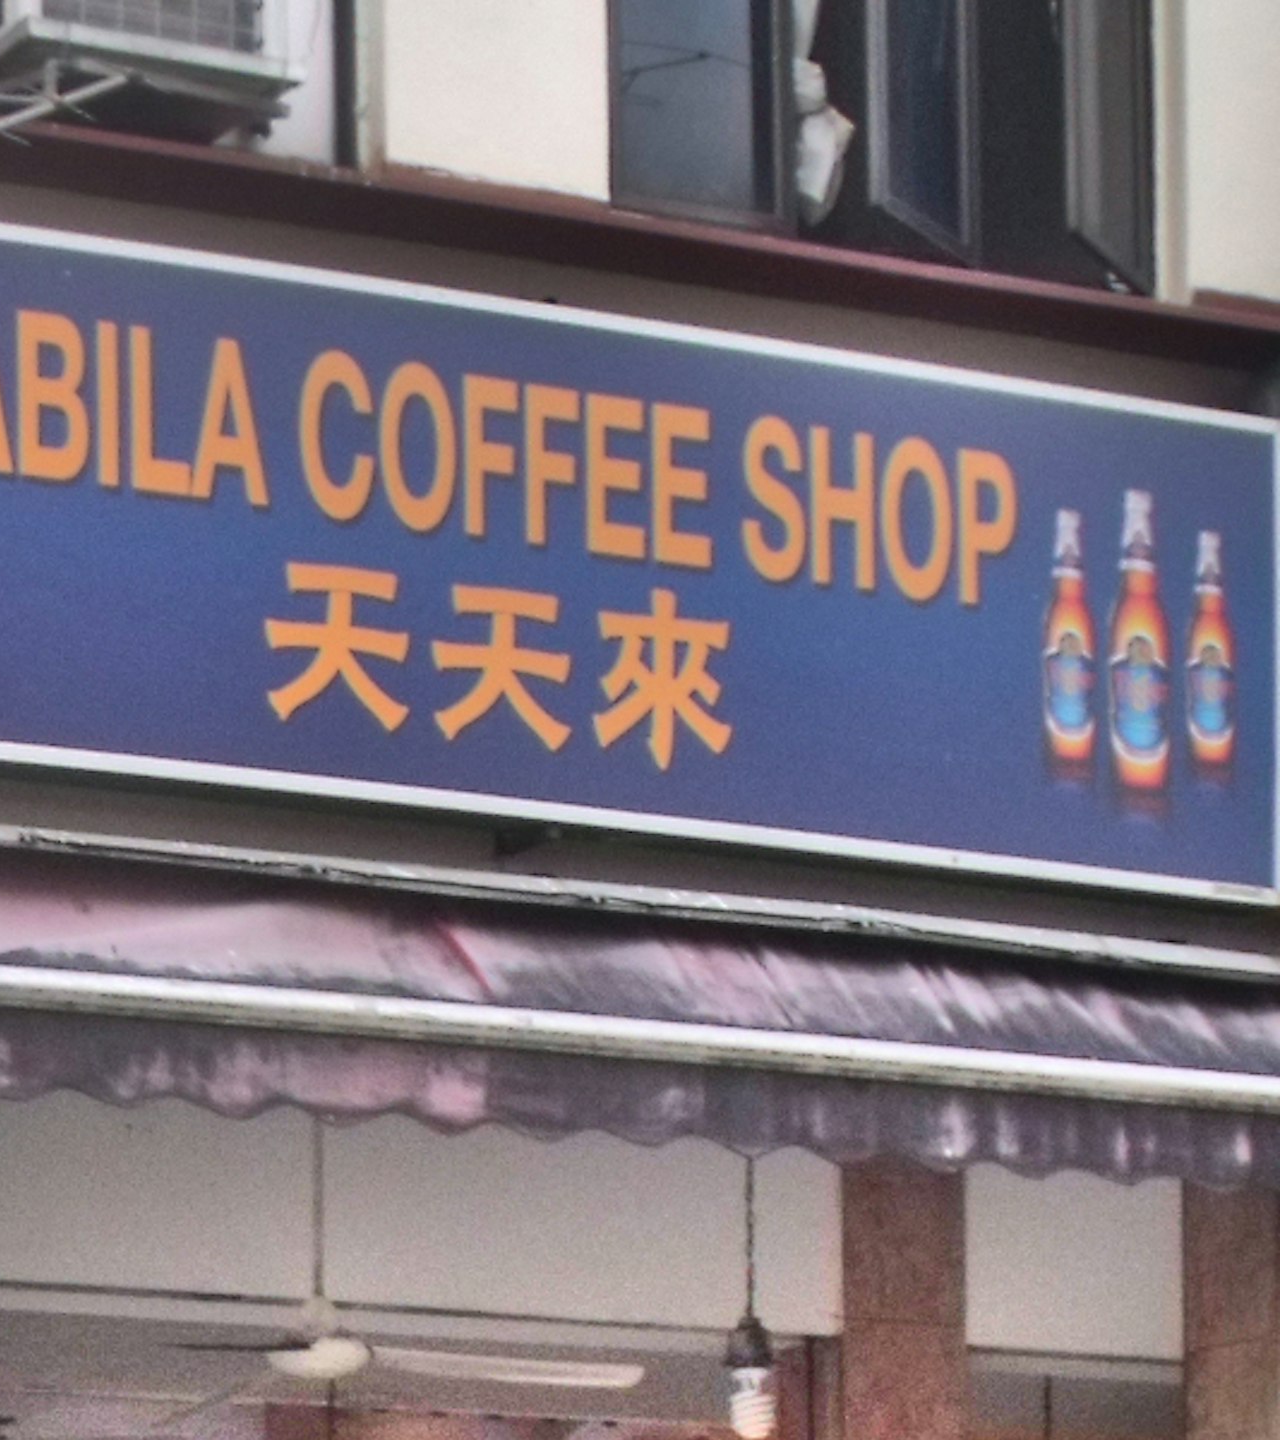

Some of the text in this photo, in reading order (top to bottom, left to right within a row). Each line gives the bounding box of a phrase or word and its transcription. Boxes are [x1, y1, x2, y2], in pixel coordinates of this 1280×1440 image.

[297, 347, 714, 571] COFFEE
[740, 414, 1019, 605] SHOP
[263, 560, 734, 771] 天天來
